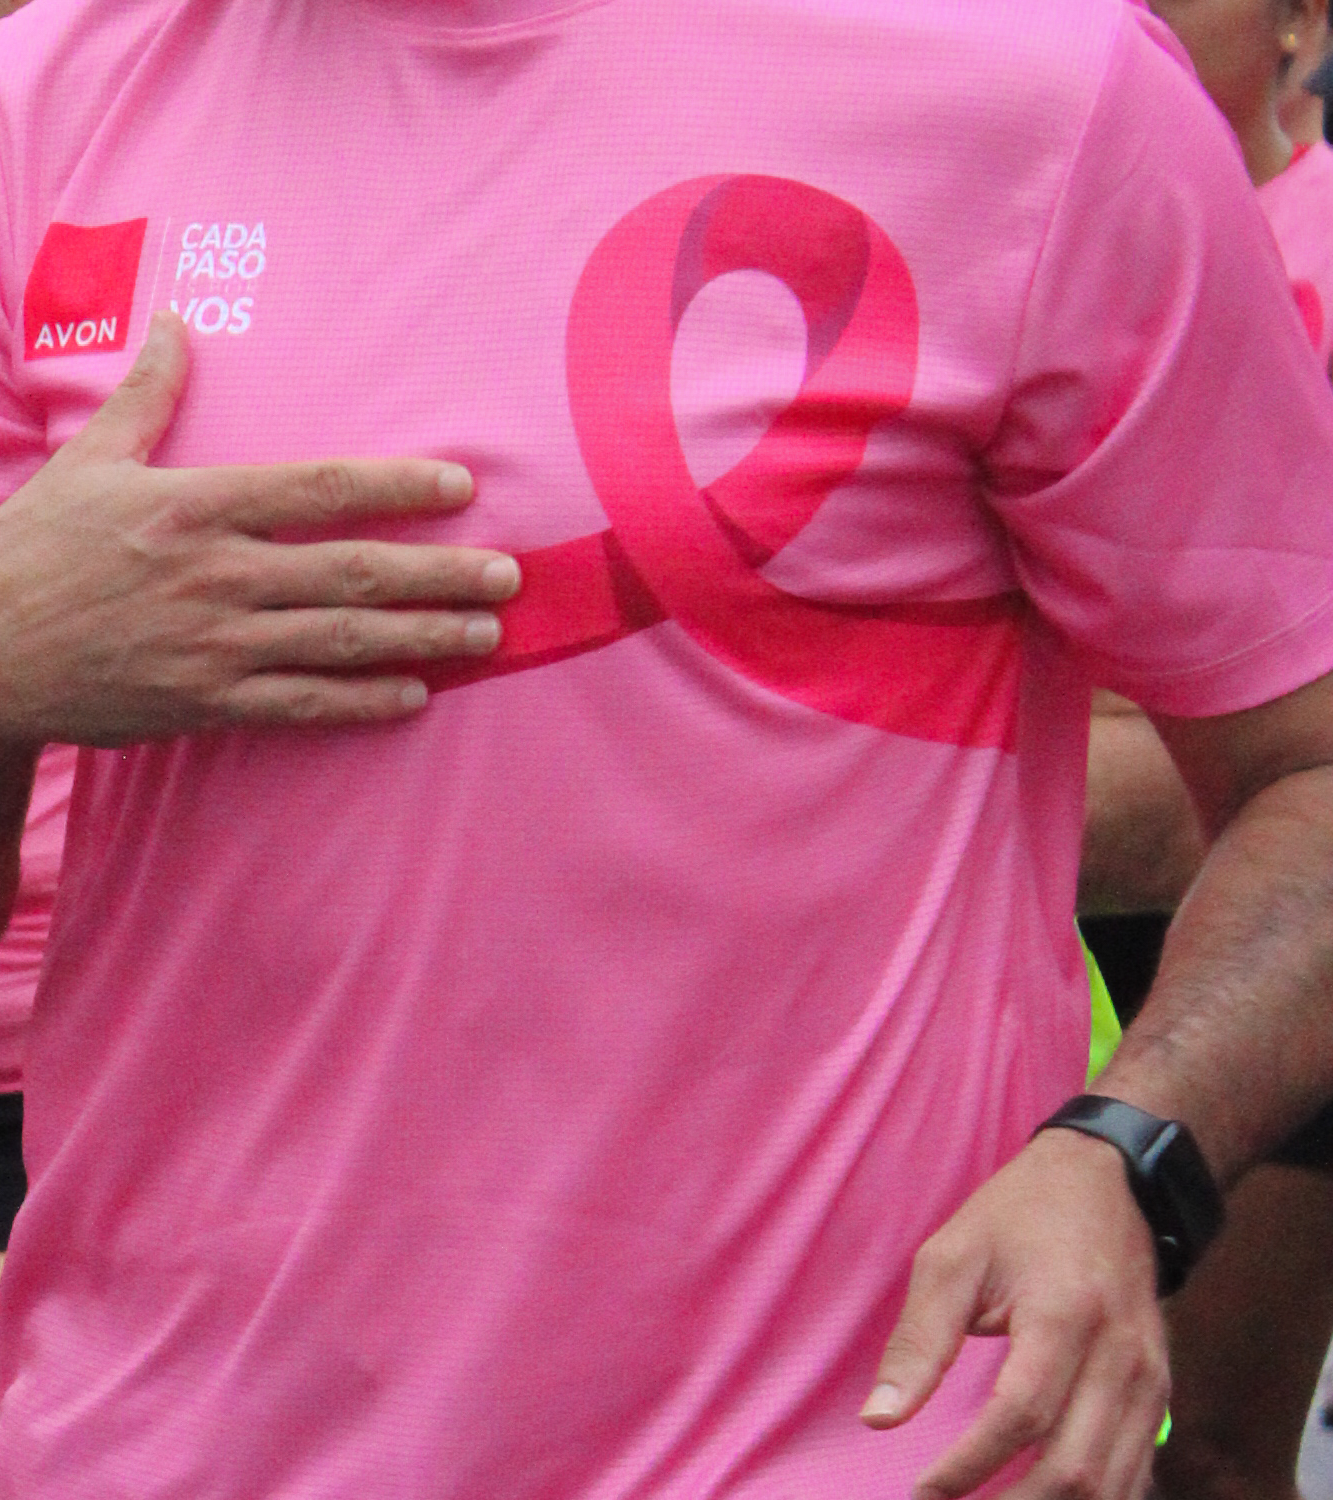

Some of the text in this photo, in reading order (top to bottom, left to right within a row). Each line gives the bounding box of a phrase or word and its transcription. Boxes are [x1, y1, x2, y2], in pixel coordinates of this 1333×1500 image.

[181, 221, 267, 250] CADA
[174, 249, 267, 281] PASO
[34, 317, 117, 350] AVON
